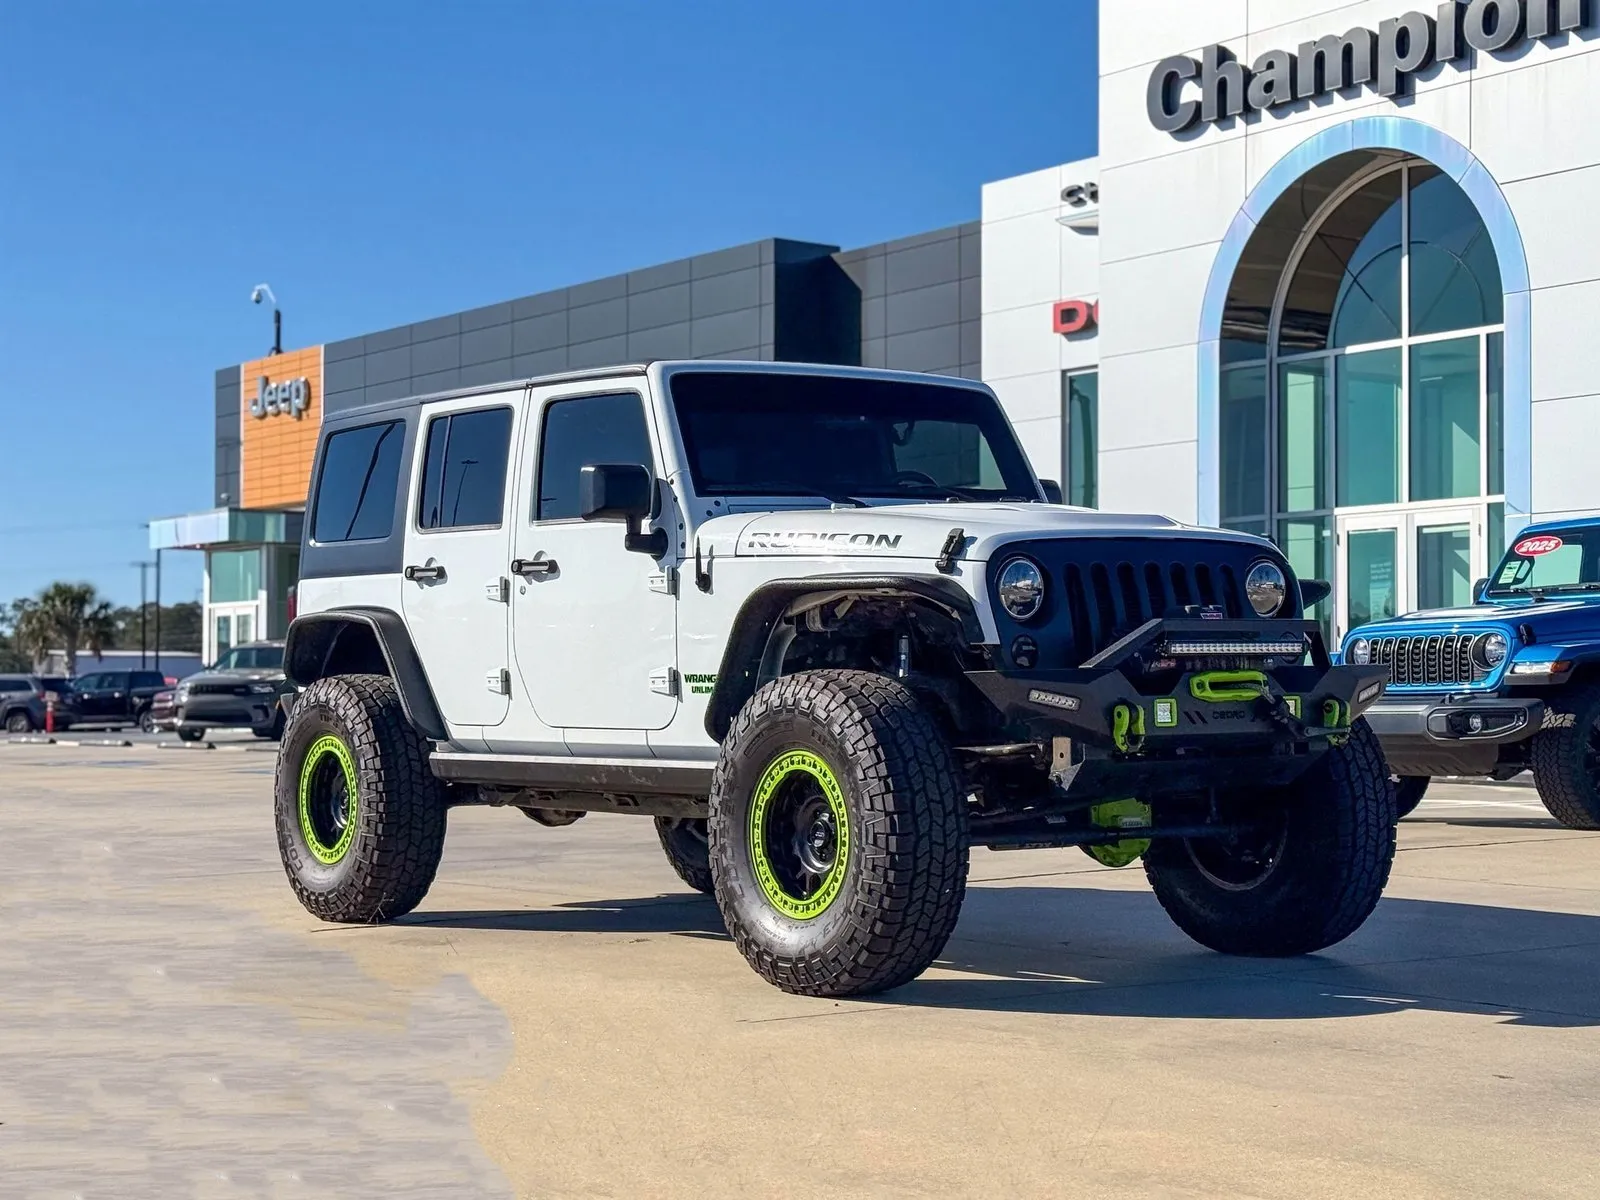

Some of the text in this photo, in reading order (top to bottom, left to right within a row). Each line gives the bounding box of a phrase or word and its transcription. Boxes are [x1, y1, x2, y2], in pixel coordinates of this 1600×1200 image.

[1147, 0, 1586, 134] Champion
[1053, 299, 1098, 336] D
[248, 375, 311, 420] Jeep
[748, 532, 902, 550] RUBICON
[1518, 540, 1559, 553] 2025
